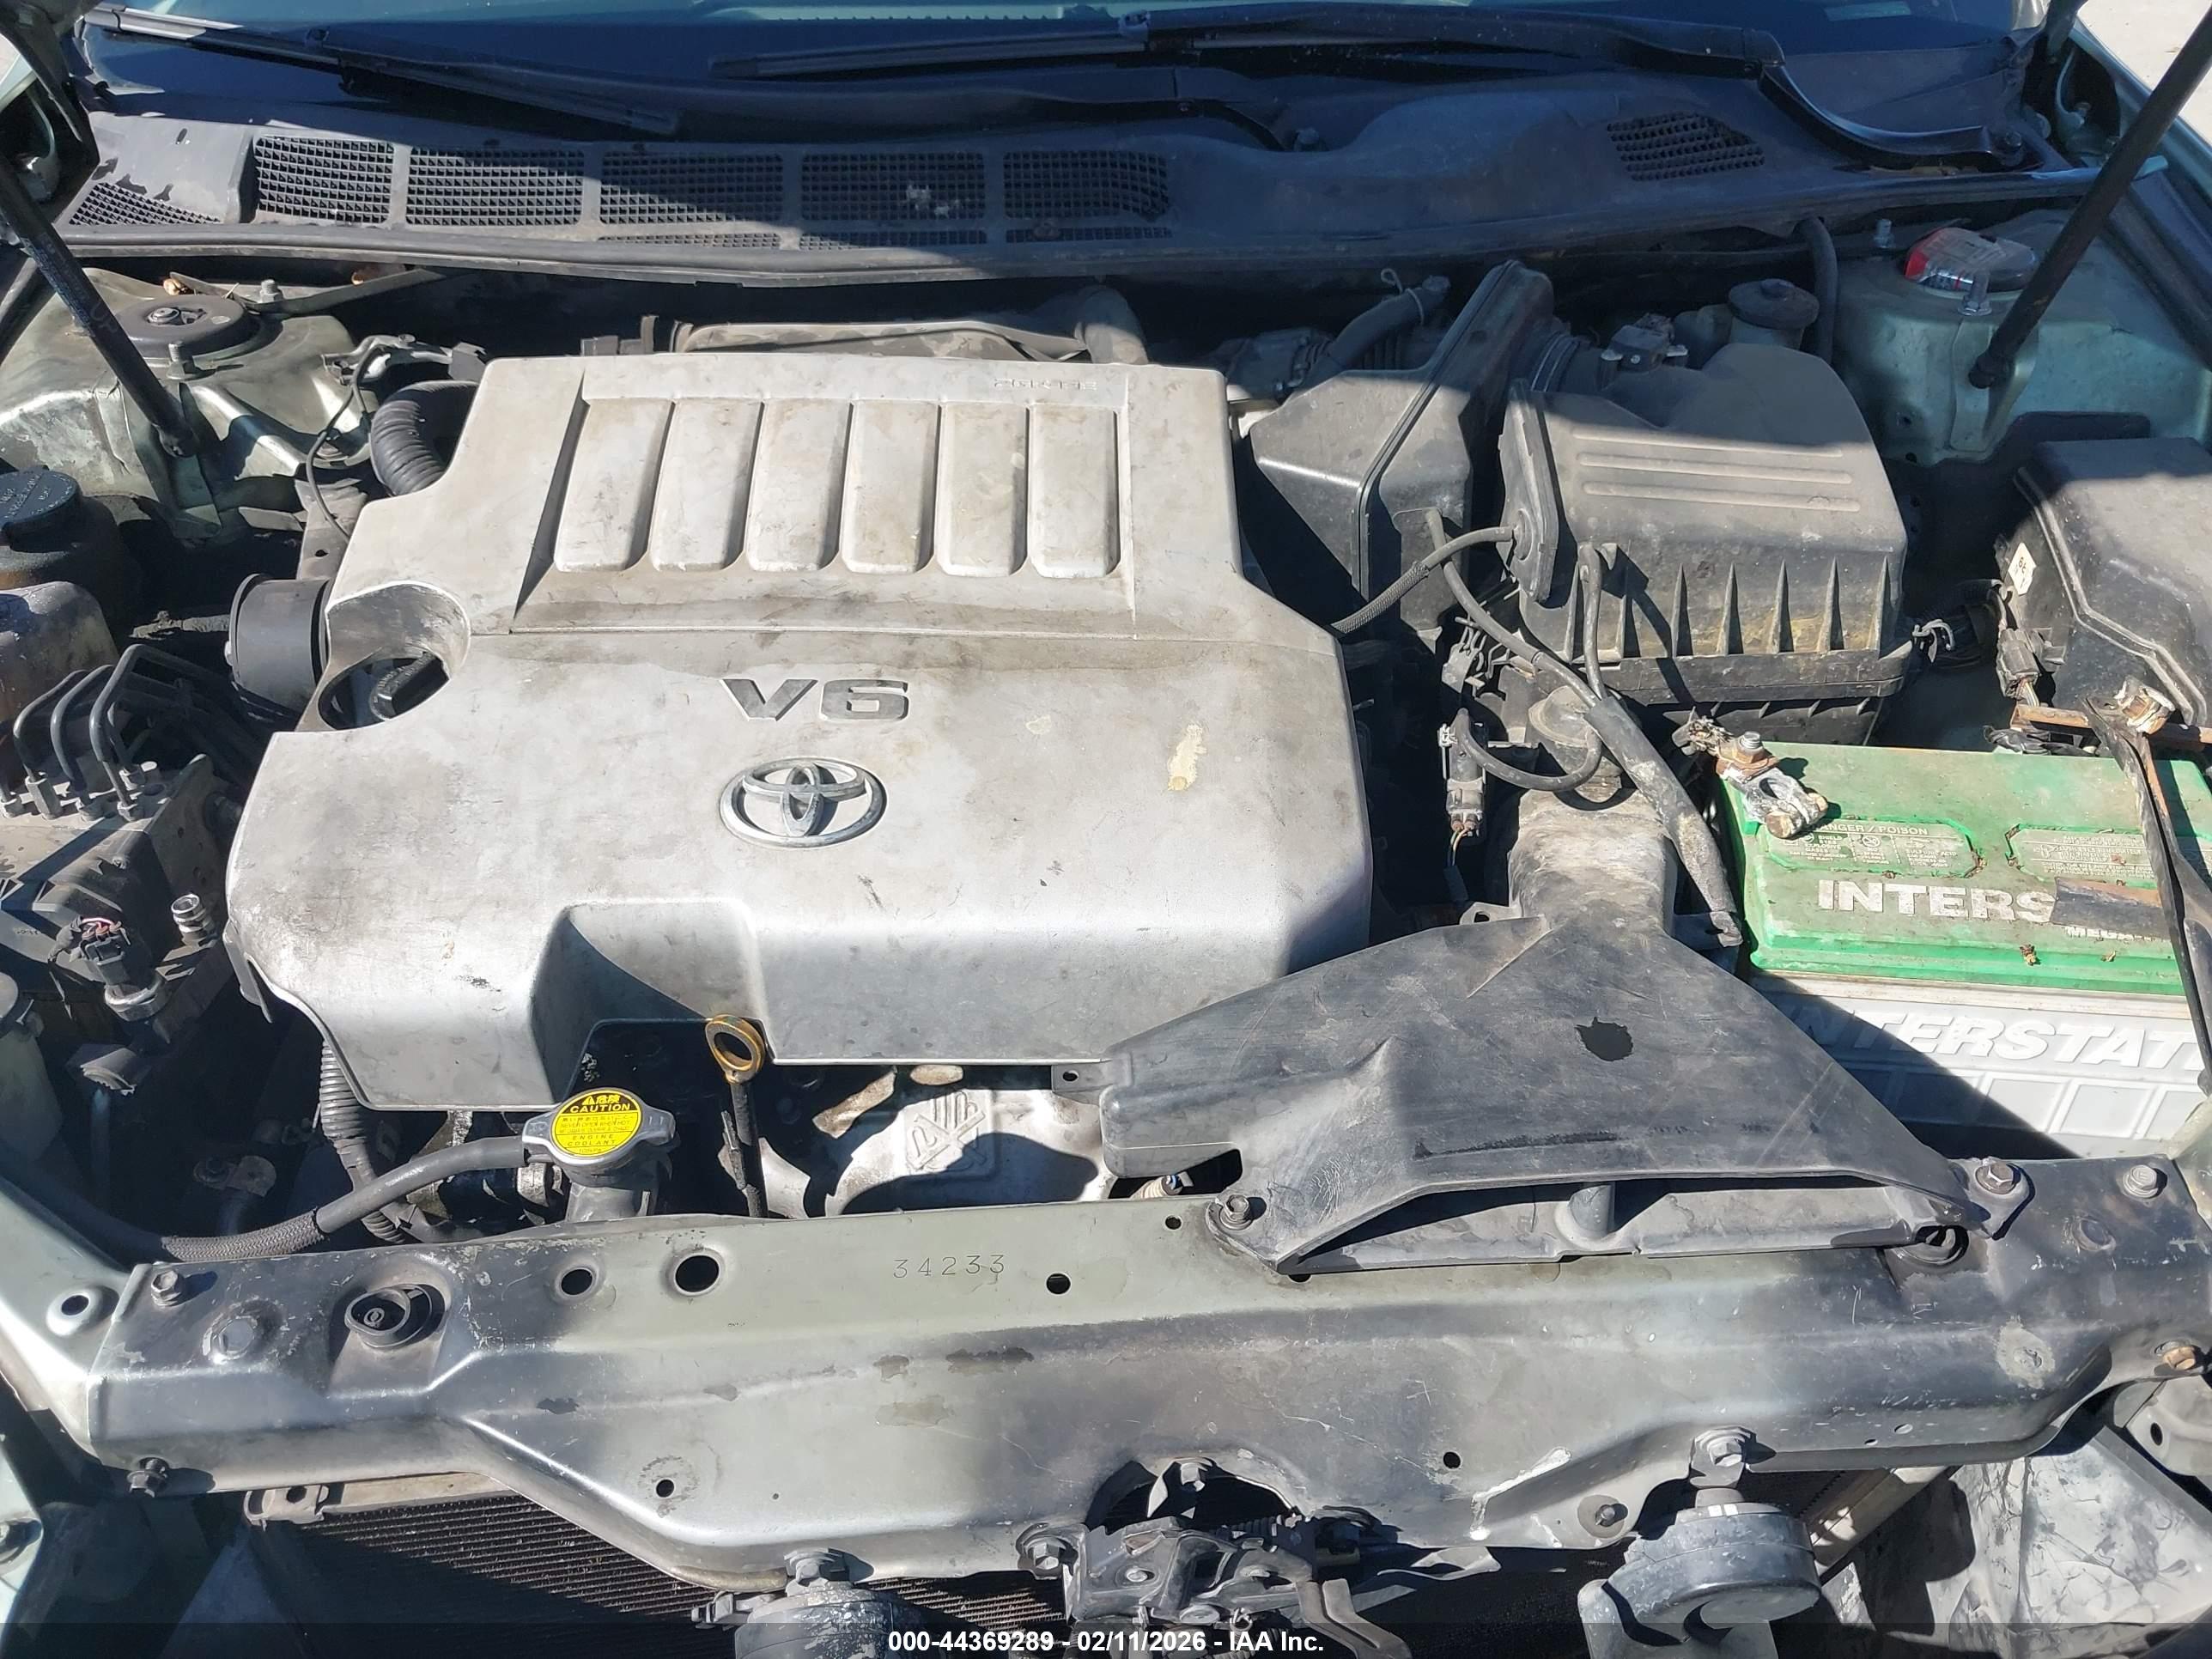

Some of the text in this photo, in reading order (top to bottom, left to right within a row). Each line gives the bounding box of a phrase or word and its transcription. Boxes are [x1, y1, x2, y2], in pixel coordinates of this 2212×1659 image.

[720, 678, 910, 722] V6
[1819, 823, 1865, 832] ANGER
[1878, 825, 1929, 836] POISON
[1818, 879, 2058, 923] INTERS
[1779, 1004, 2195, 1071] NTERSTAT
[569, 1103, 631, 1114] CAUTION
[892, 1254, 1005, 1279] 34233
